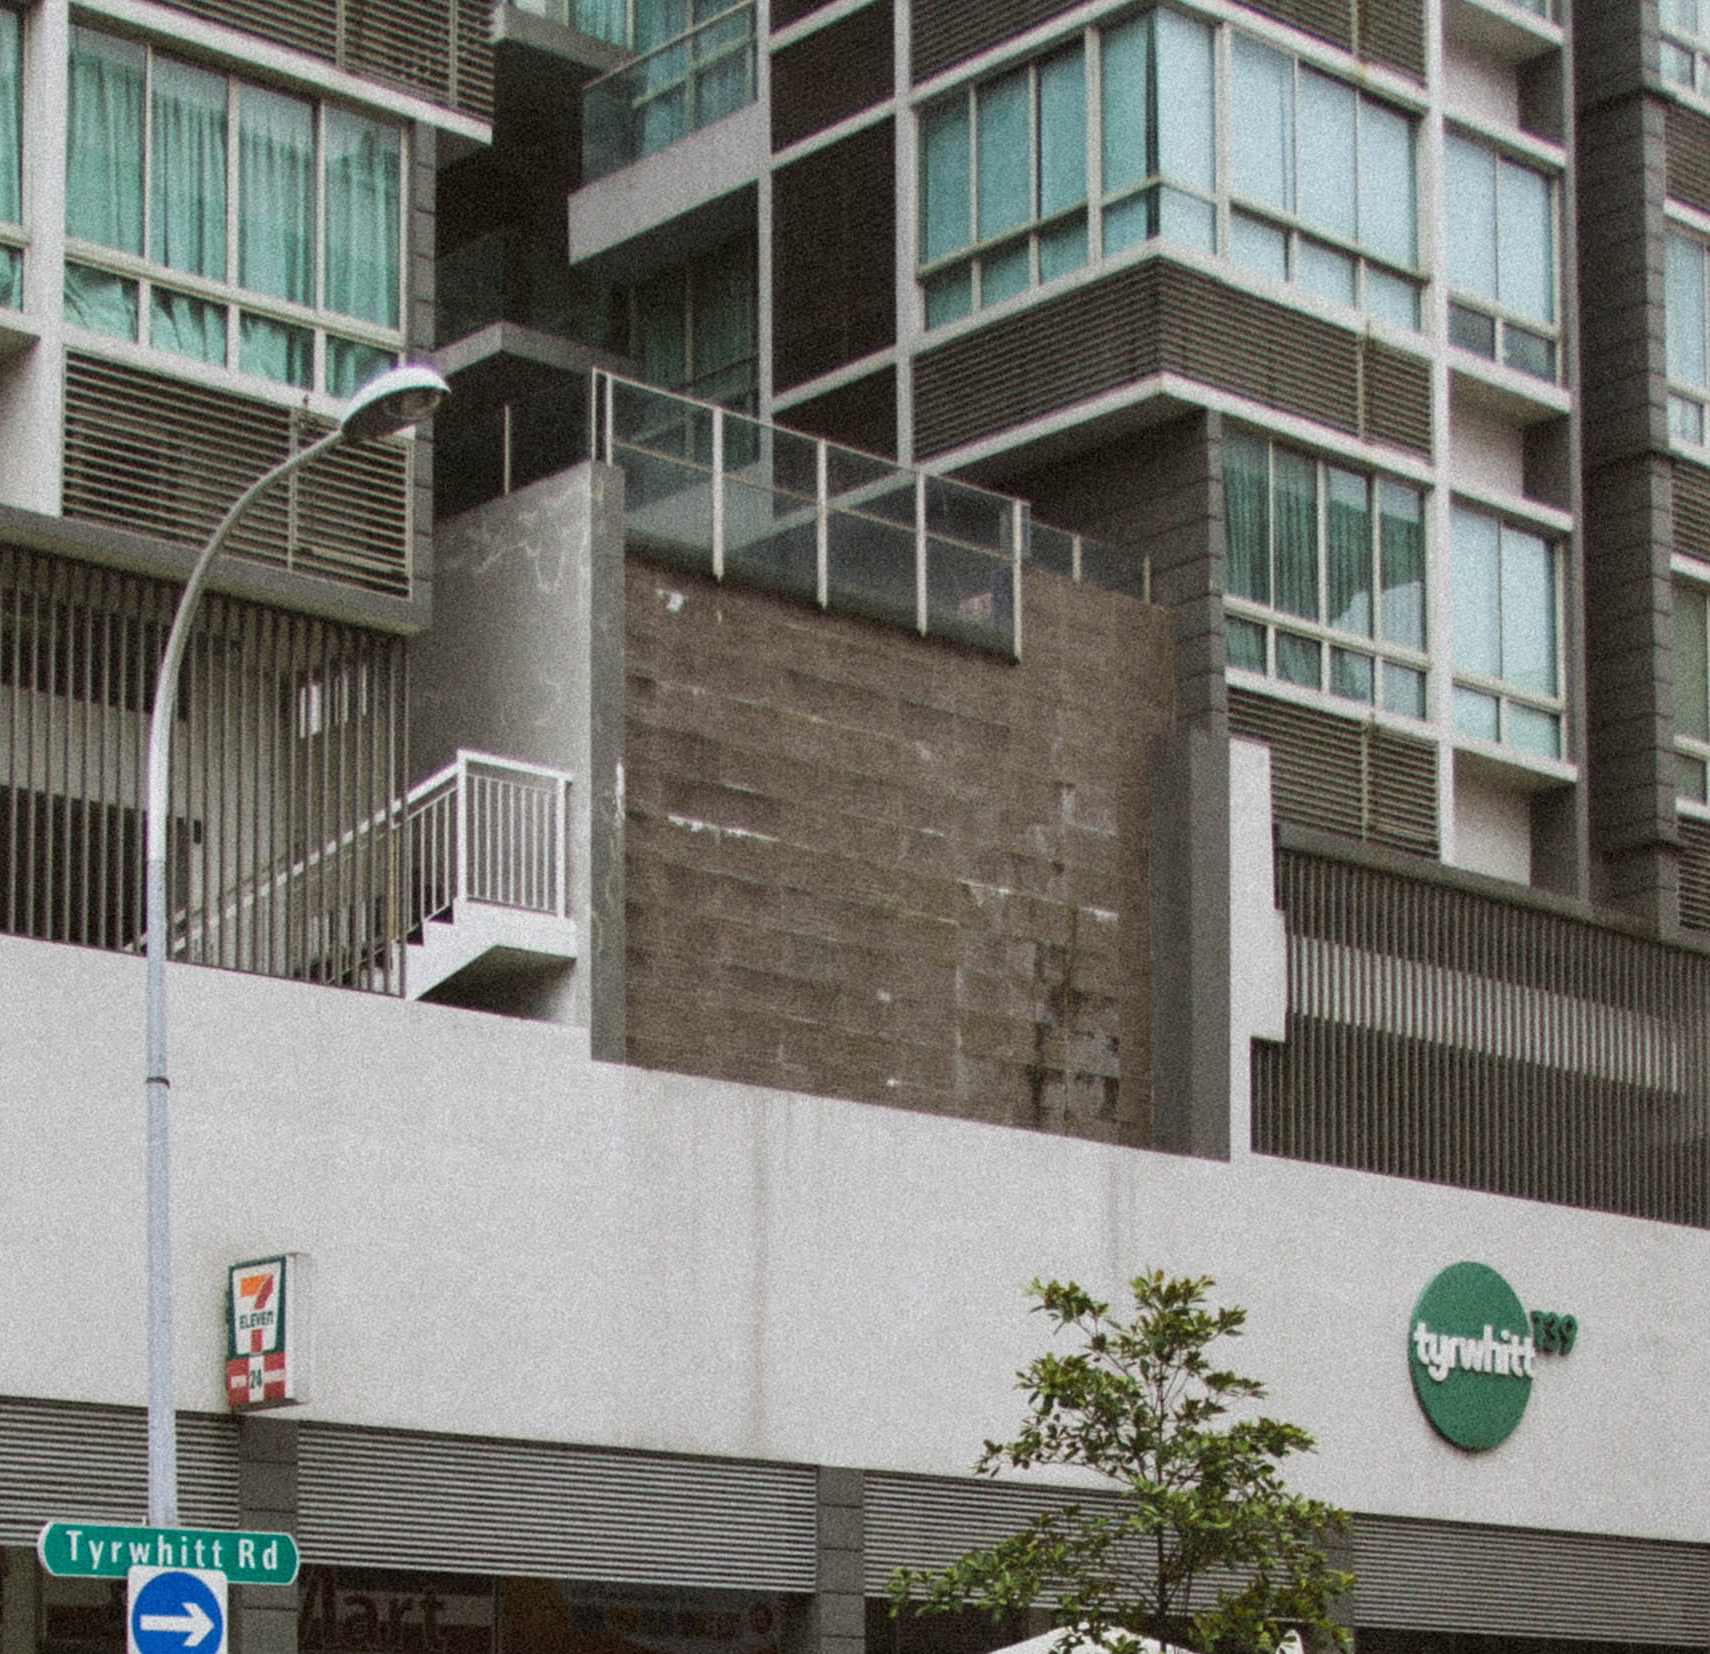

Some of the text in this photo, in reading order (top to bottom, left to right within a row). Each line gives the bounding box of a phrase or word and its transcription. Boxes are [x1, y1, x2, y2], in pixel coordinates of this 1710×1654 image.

[1413, 1310, 1579, 1382] tyrwhitt 139
[66, 1529, 278, 1570] Tyrwhitt Rd
